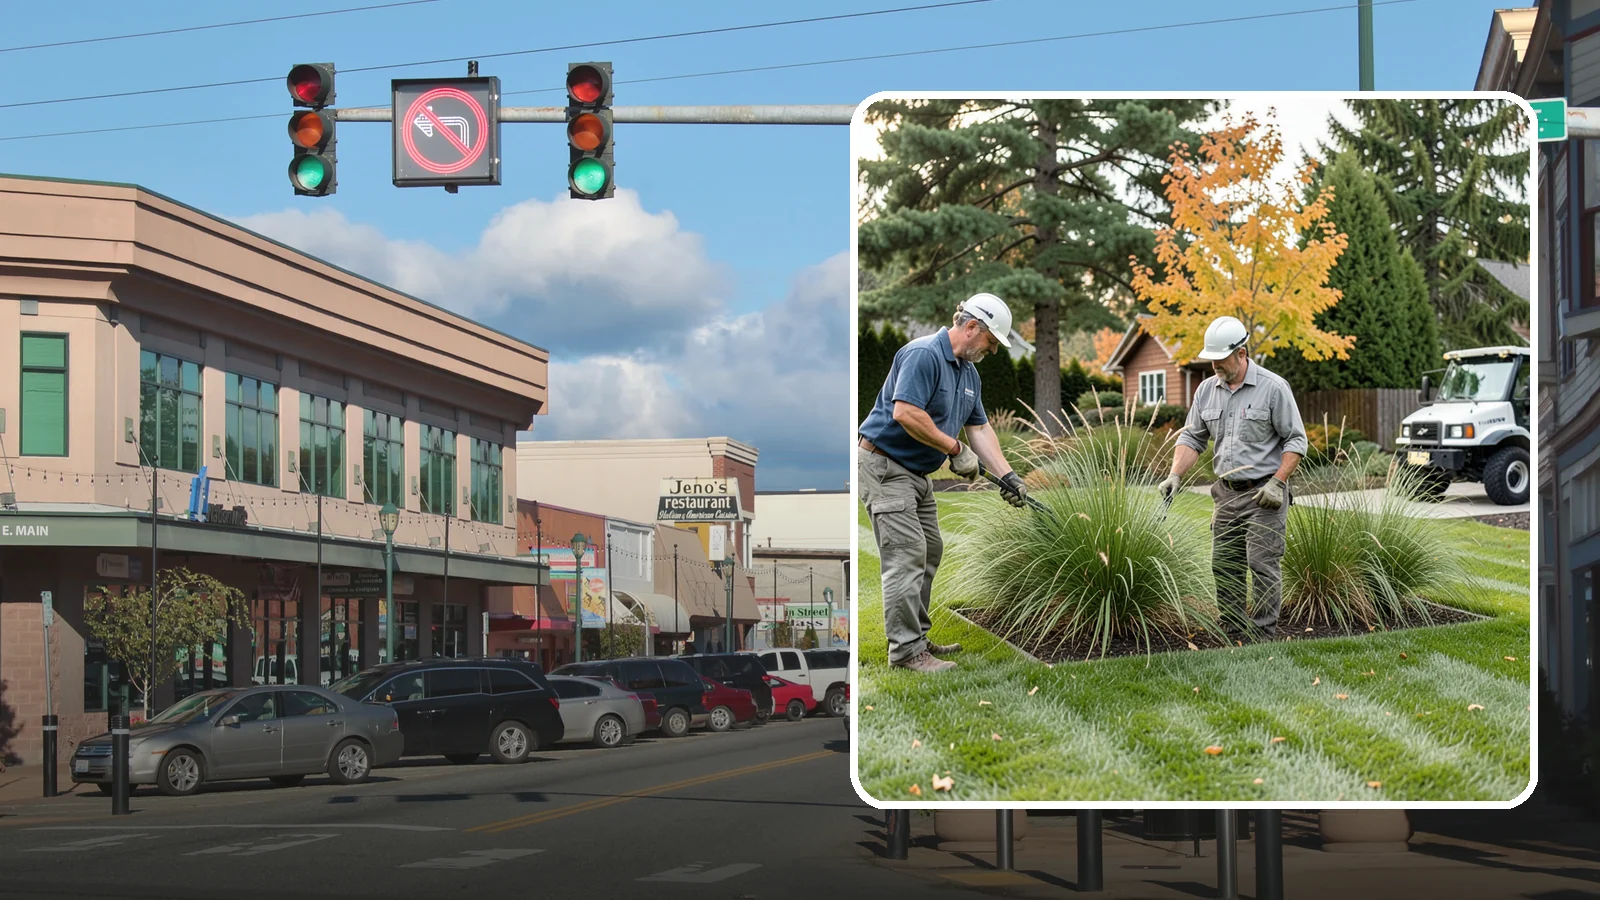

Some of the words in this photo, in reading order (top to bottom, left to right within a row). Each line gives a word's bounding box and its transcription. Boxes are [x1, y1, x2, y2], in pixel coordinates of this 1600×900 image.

[670, 480, 727, 494] Jeno's
[665, 496, 731, 509] restaurant
[659, 510, 681, 519] Italian
[686, 510, 714, 520] American
[715, 509, 737, 519] Cuisine
[2, 525, 13, 536] E.
[15, 525, 49, 536] MAIN
[797, 608, 829, 617] Street
